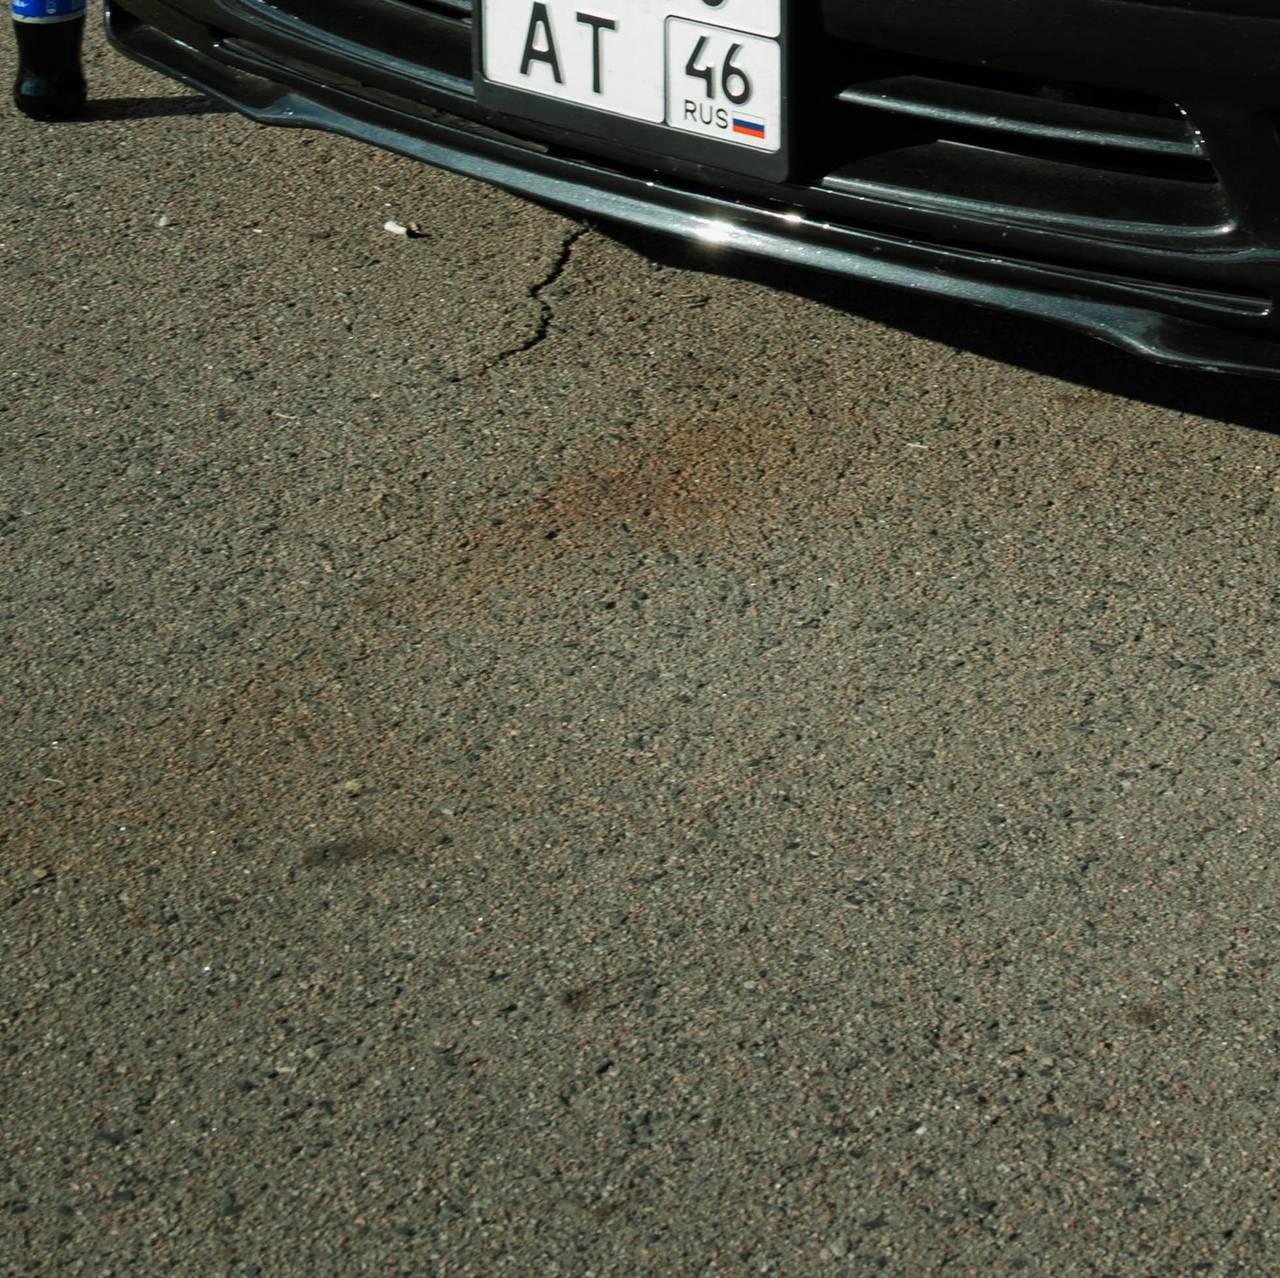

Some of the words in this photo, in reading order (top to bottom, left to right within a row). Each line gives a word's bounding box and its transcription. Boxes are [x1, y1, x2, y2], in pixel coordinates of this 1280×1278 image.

[519, 1, 617, 94] AT
[685, 35, 753, 105] 46
[684, 99, 729, 130] RUS
